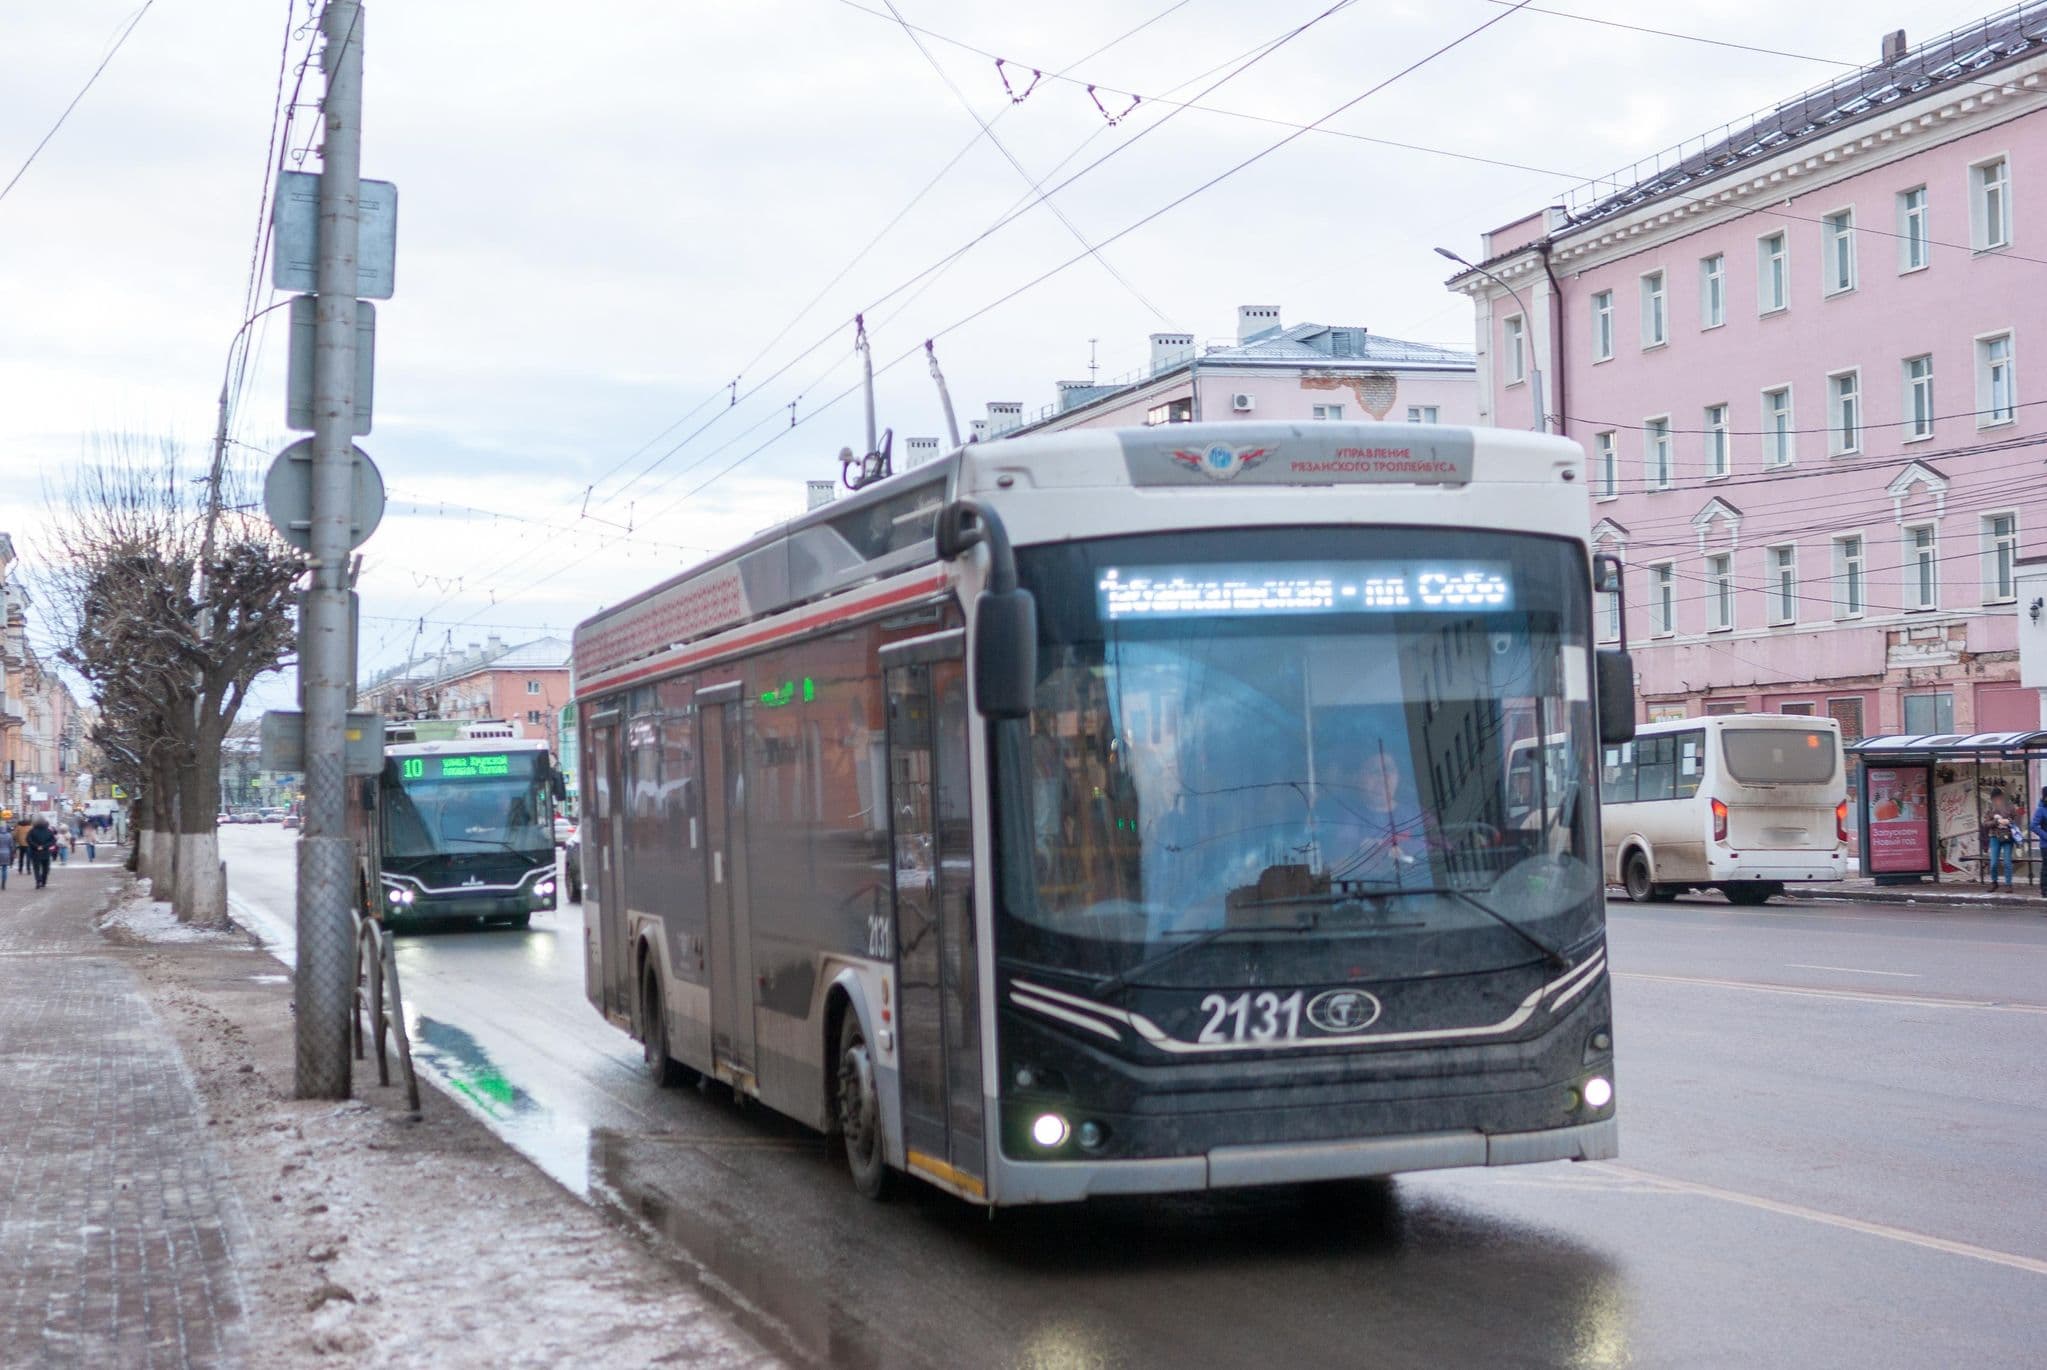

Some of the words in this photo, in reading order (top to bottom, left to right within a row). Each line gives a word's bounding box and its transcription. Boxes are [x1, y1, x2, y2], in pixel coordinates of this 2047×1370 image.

[1336, 447, 1411, 459] УПРАВЛЕНИЕ
[1291, 461, 1370, 473] РЯЗАНСКОГО
[1374, 459, 1457, 473] ТРОЛЛЕЙБУСА
[403, 758, 423, 777] 10
[868, 914, 889, 958] 2131
[1198, 990, 1304, 1044] 2131
